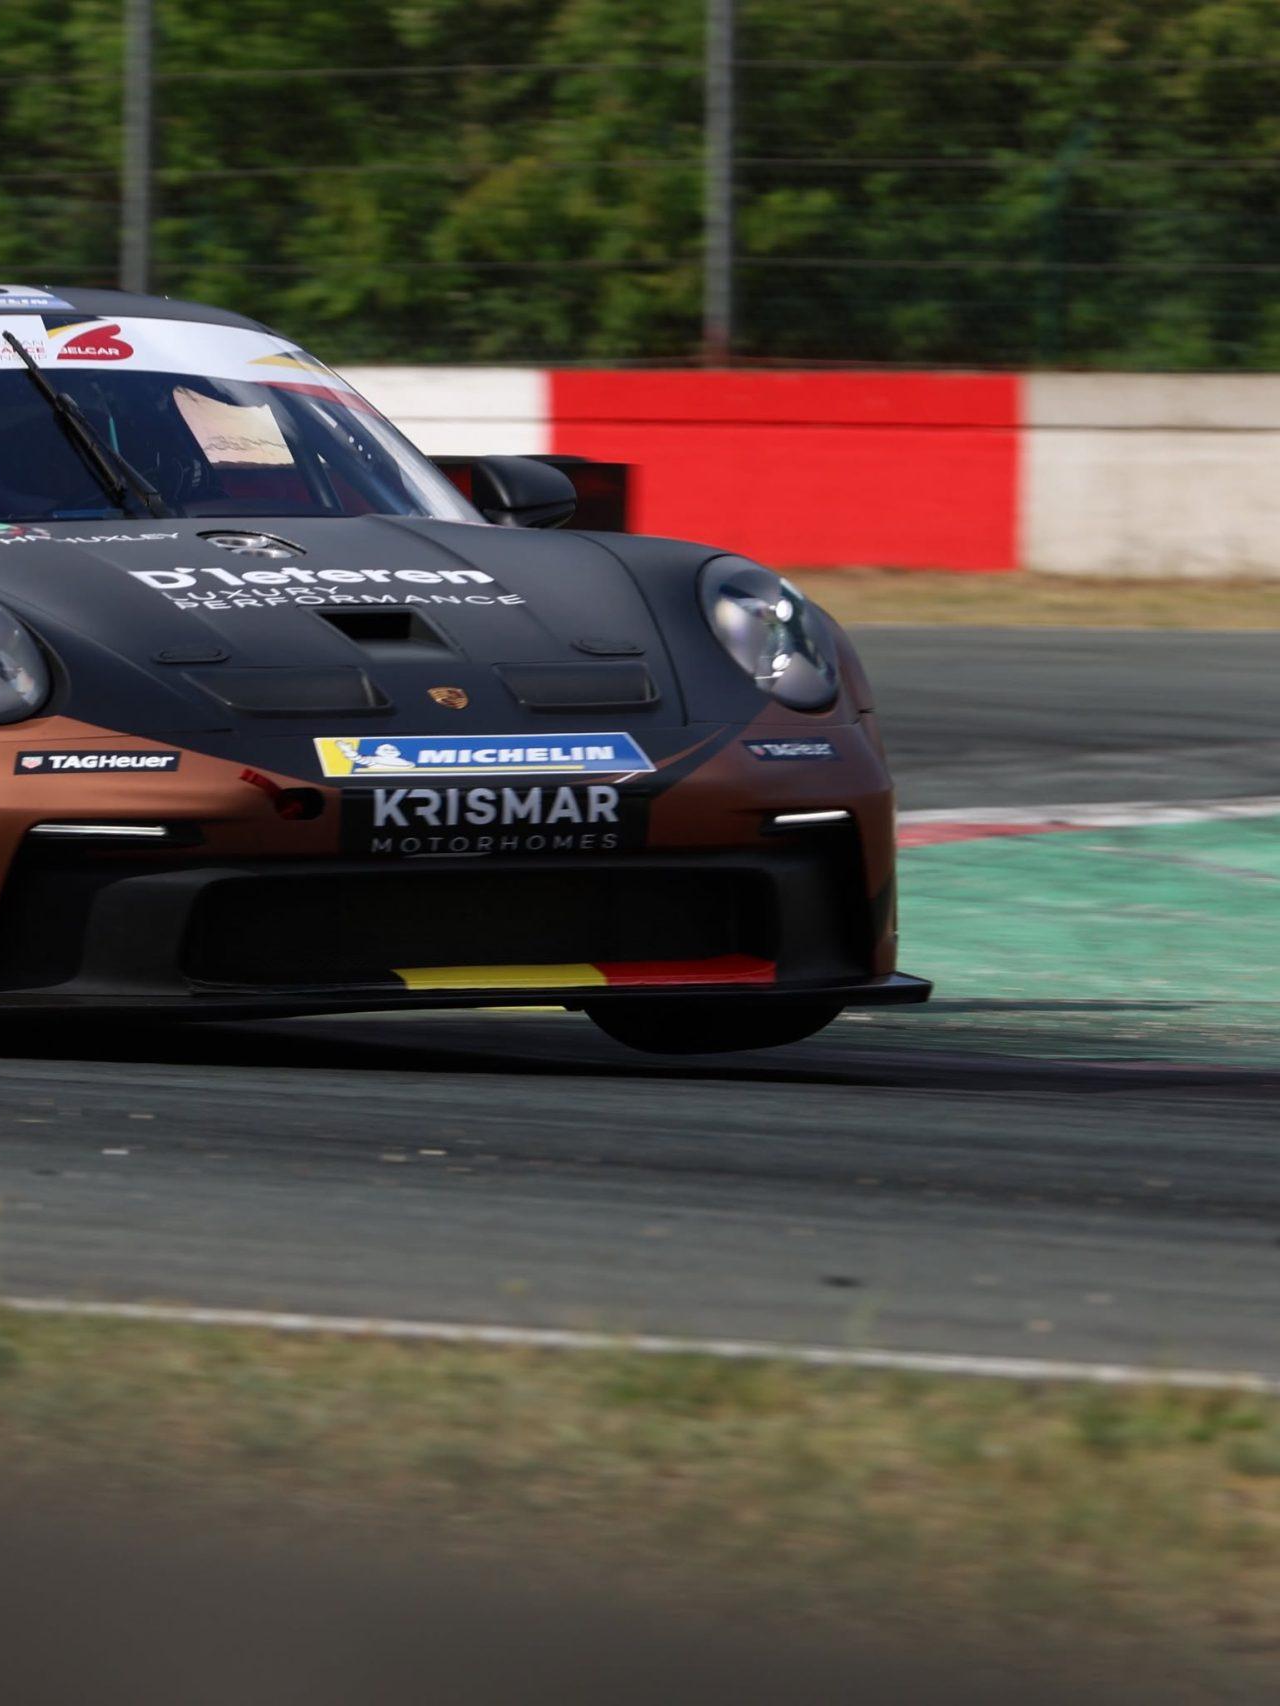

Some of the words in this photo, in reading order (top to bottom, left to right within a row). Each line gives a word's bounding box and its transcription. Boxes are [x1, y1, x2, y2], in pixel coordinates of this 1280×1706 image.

[61, 346, 121, 356] BELCAR
[162, 585, 340, 601] LUXURY
[174, 593, 526, 610] PERFORMANCE
[418, 746, 615, 764] MICHELIN
[373, 785, 621, 827] KRISMAR
[372, 833, 619, 854] MOTORHOMES
